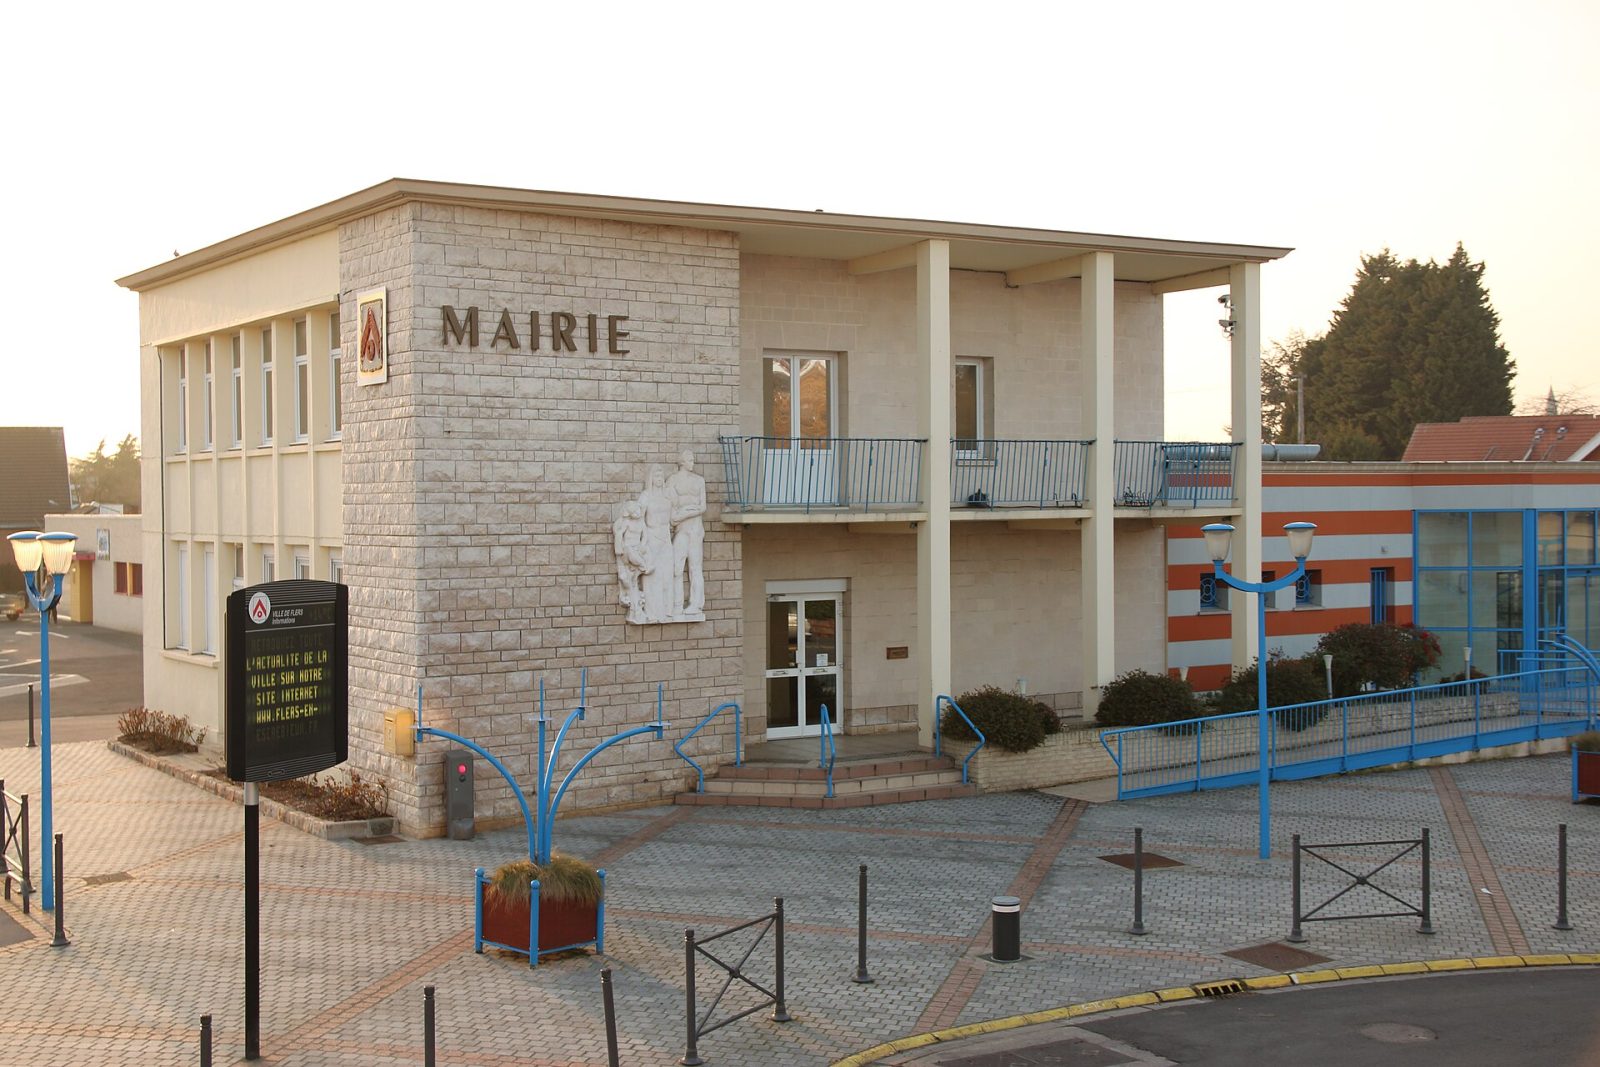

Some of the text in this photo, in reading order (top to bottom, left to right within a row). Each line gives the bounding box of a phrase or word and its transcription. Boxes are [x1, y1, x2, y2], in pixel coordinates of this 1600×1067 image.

[443, 305, 631, 354] MAIRIE
[272, 610, 284, 618] VILLE
[284, 609, 290, 617] DE
[290, 608, 304, 616] FLERS
[246, 650, 328, 671] L'ACTUALITE DE LA
[251, 668, 323, 689] VILLE SUR NOTRE
[256, 686, 319, 706] SITE INTERNET
[256, 703, 319, 724] WWW.FLERS-EN-
